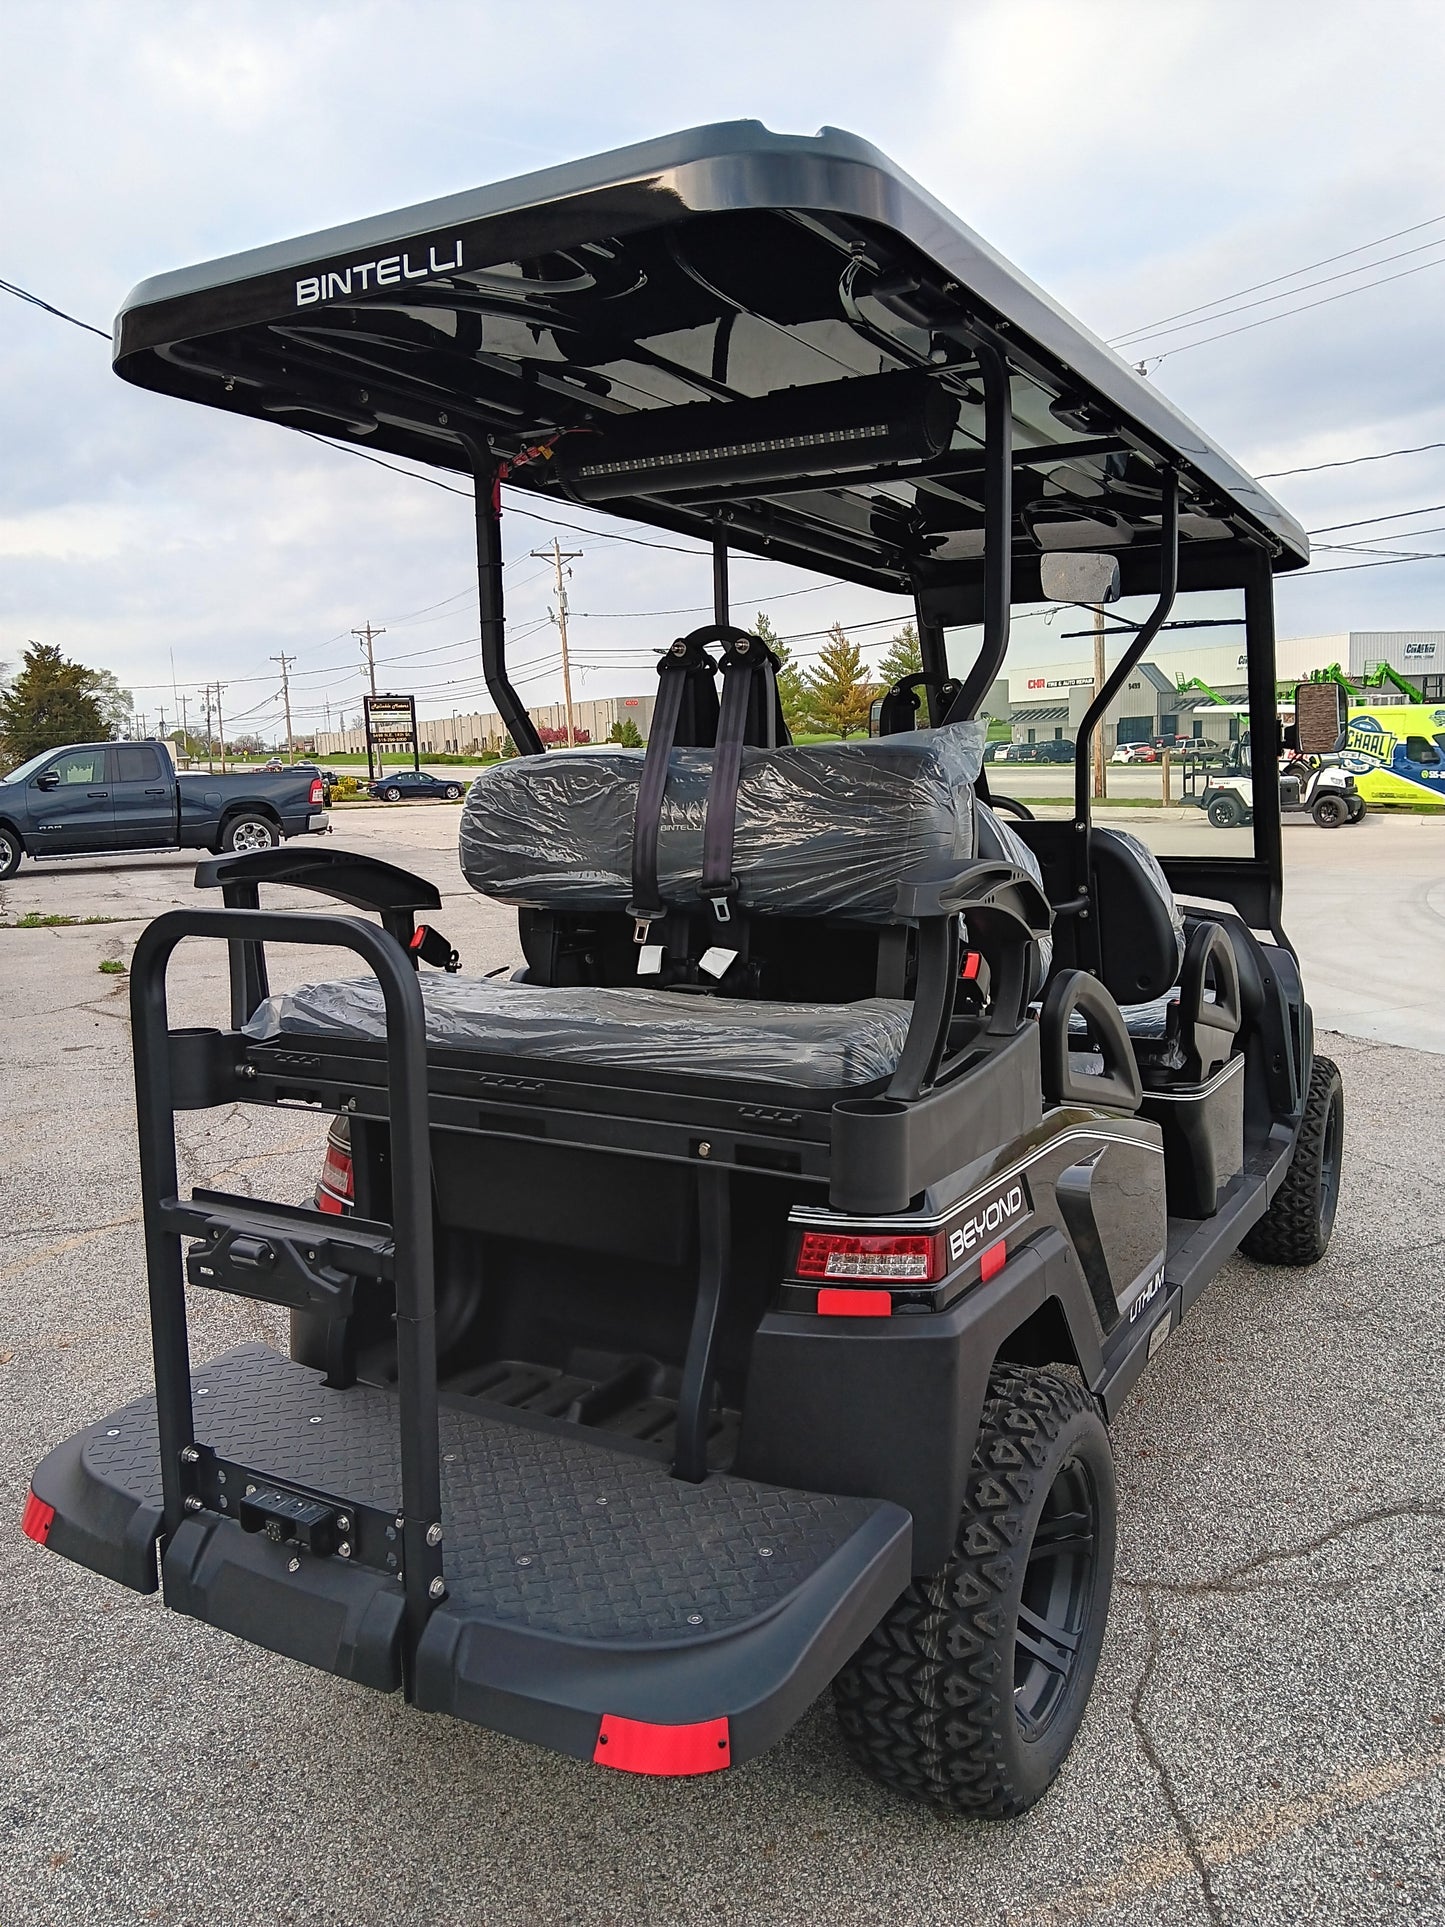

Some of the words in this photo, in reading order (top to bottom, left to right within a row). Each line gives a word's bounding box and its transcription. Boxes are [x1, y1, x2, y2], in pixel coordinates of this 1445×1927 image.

[296, 240, 463, 306] BINTELLI
[1028, 679, 1045, 689] CHR
[1063, 679, 1076, 687] AUTO
[1076, 678, 1093, 686] REPAIR
[1347, 729, 1385, 756] CHAAL
[949, 1186, 1021, 1261] BEYOND
[1130, 1265, 1165, 1323] LITHIUM
